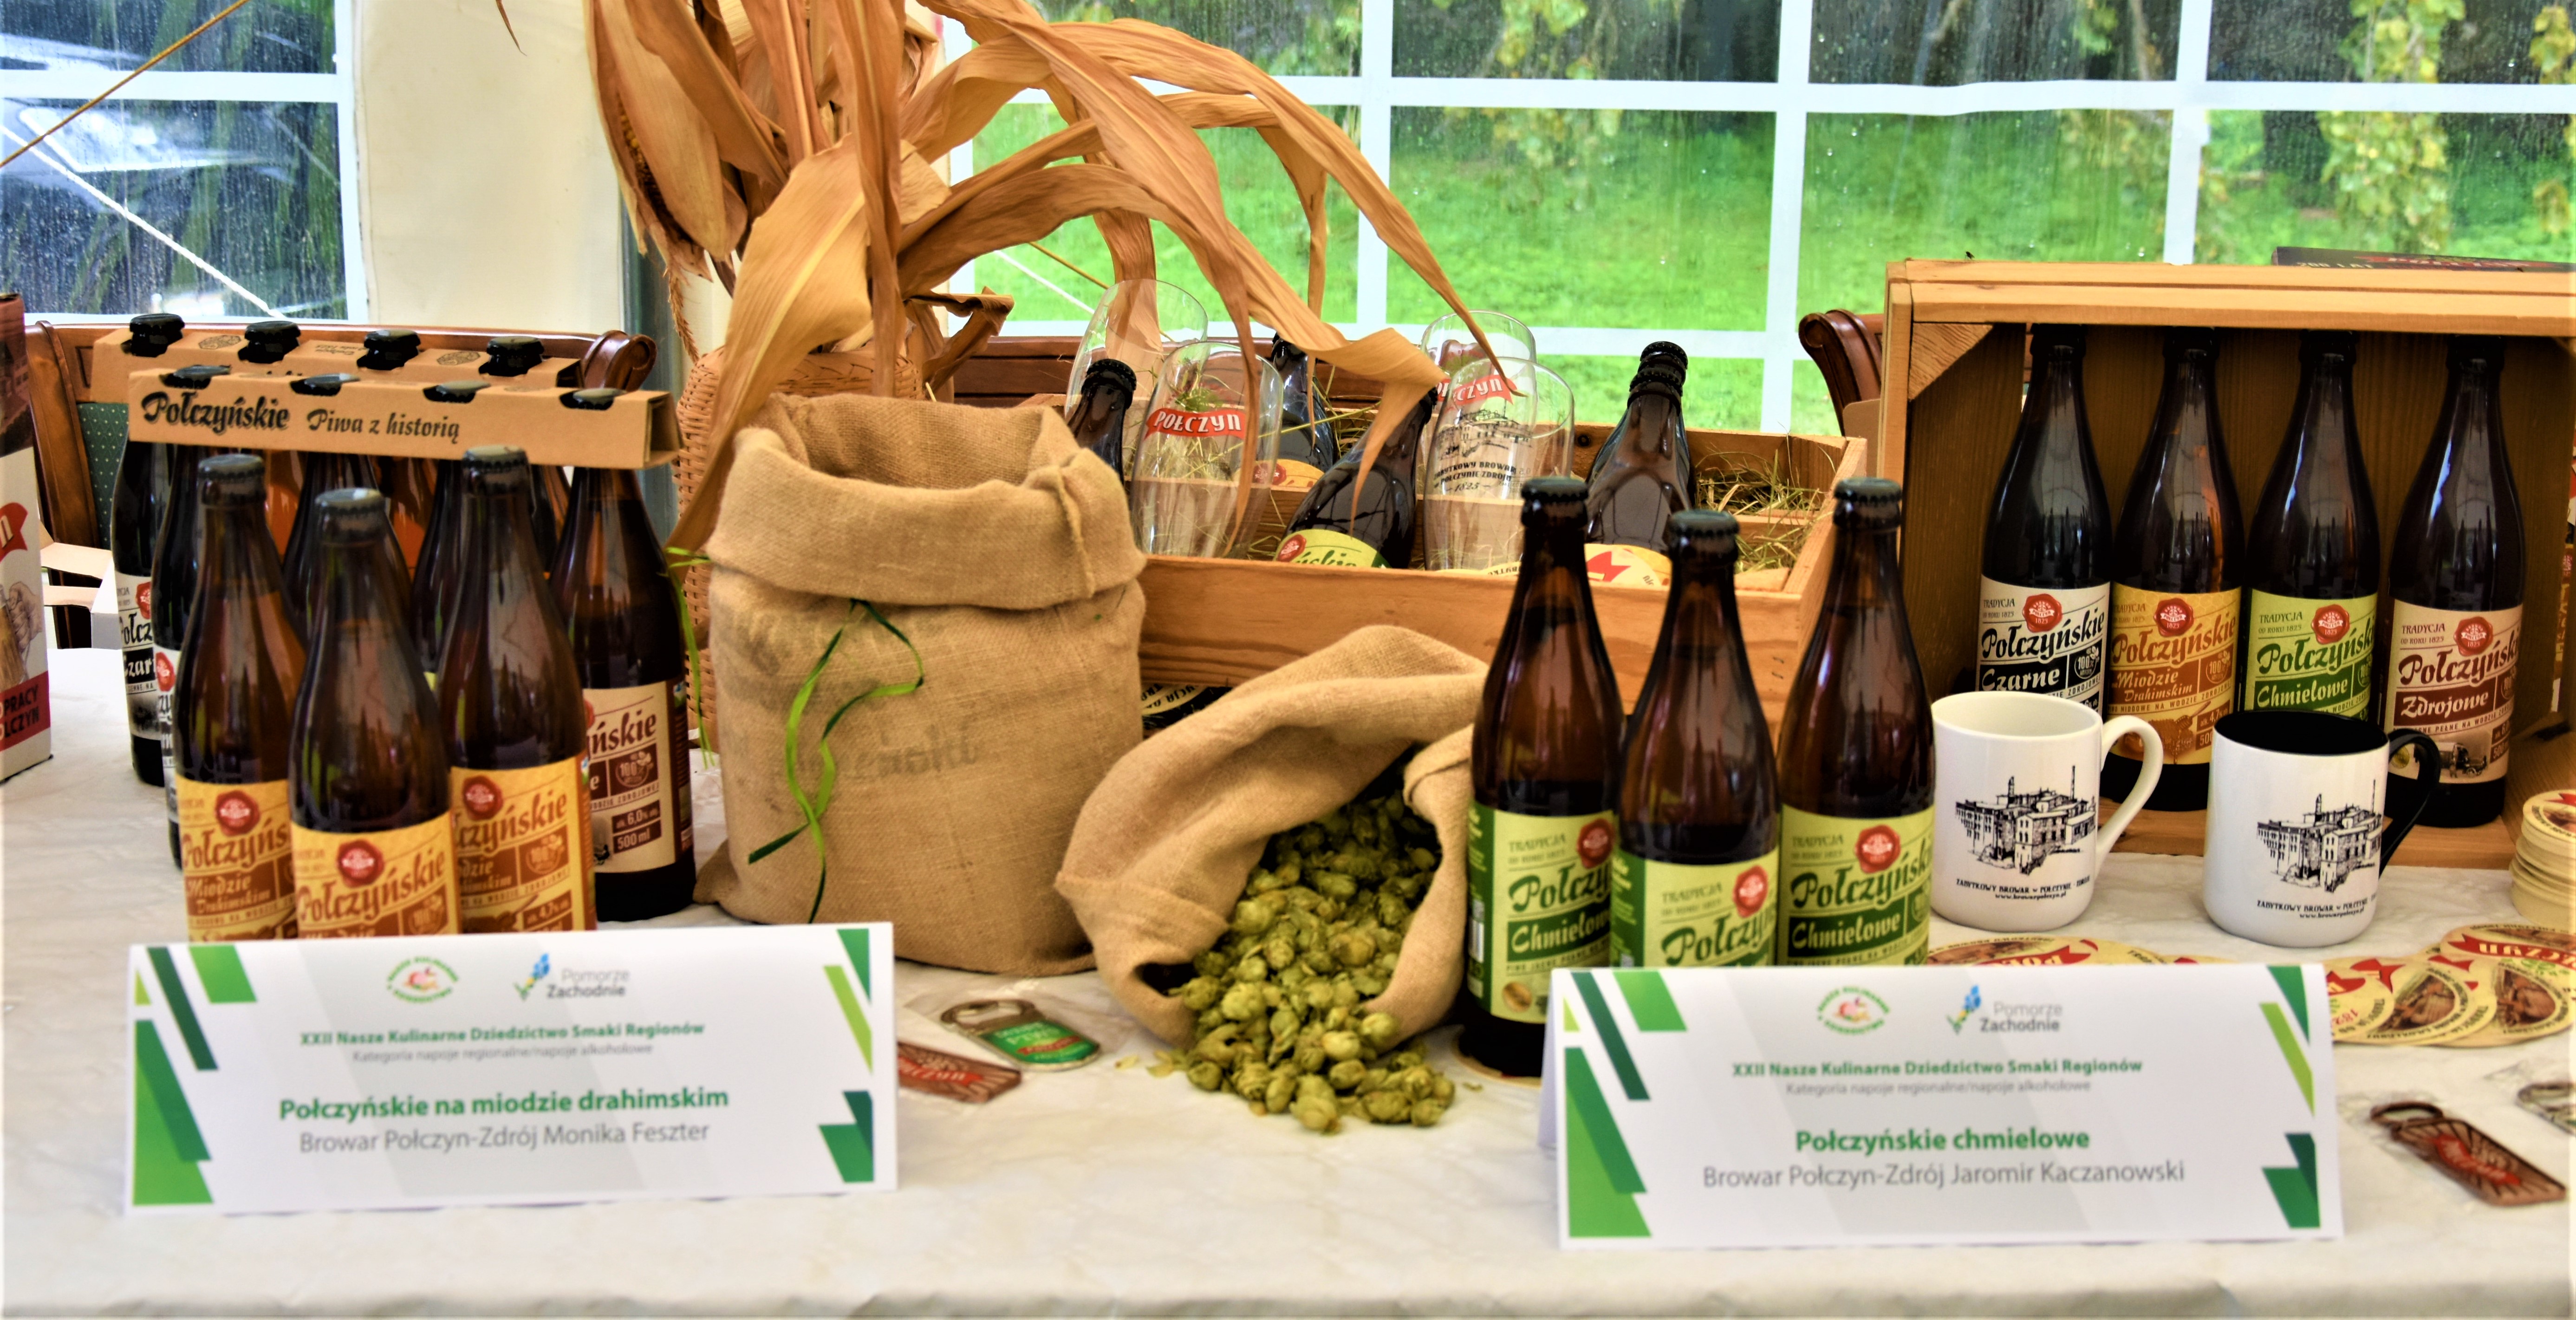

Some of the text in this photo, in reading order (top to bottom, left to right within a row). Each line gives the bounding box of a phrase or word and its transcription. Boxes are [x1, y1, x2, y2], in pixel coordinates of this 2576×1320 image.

[141, 391, 460, 444] Połczyńskie Piwa z historią
[1153, 411, 1241, 433] POŁCZYN
[1441, 471, 1480, 484] POŁCZYNIE
[1480, 462, 1517, 475] BROWAR
[1455, 482, 1480, 491] 1825
[1983, 598, 2016, 608] TRADYCJA
[2259, 611, 2303, 624] TRADYCJA
[1981, 607, 2105, 661] Połczyńskie
[2112, 611, 2237, 664] Połczyńskie
[2401, 623, 2446, 635] TRADYCJA
[1981, 668, 2061, 691] Czarne
[2068, 674, 2101, 696] ZDROJOWEJ
[2117, 667, 2179, 689] Miodzie
[2124, 683, 2193, 702] Drahimskim
[2169, 697, 2197, 708] WODZIE
[2257, 678, 2348, 708] Chmielowe
[2400, 691, 2489, 718] Zdrojowe
[2435, 723, 2459, 733] PEŁNE
[2474, 712, 2497, 726] WODZIE
[460, 789, 567, 854] czyńskie
[617, 828, 651, 850] 500 ml
[1509, 834, 1566, 852] TRADYCJA
[1792, 834, 1844, 848] TRADYCJA
[296, 846, 445, 922] Połczyńskie
[1509, 863, 1610, 912] Połczy
[1956, 878, 1997, 892] ZABYTKOWY
[2257, 899, 2302, 912] ZABYTKOWY
[1661, 912, 1763, 966] Połczy
[1791, 913, 1901, 949] Chmielowe
[561, 968, 630, 983] Pomorze
[547, 984, 625, 999] Zachodnie
[1994, 1001, 2062, 1016] Pomorze
[300, 1022, 705, 1046] XXII Nasze Kulinarne Dziedzictwo Smaki Regionów
[1980, 1017, 2060, 1033] Zachodnie
[352, 1050, 414, 1064] Kategoria
[416, 1048, 459, 1063] napoje
[580, 1043, 653, 1056] alkoholowe
[1732, 1057, 2142, 1077] XXII Nasze Kulinarne Dziedzictwo Smaki Regionów
[1786, 1082, 1847, 1097] Kategoria
[1850, 1082, 1893, 1096] napoje
[2018, 1079, 2091, 1093] alkoholowe
[280, 1085, 729, 1124] Połczyńskie na miodzie drahimskim
[300, 1122, 710, 1154] Browar Połczyn-Zdrój Monika Feszter
[1796, 1126, 2090, 1157] Połczyńskie chmielowe
[1703, 1159, 2185, 1191] Browar Połczyn-Zdrój Jaromir Kaczanowski
